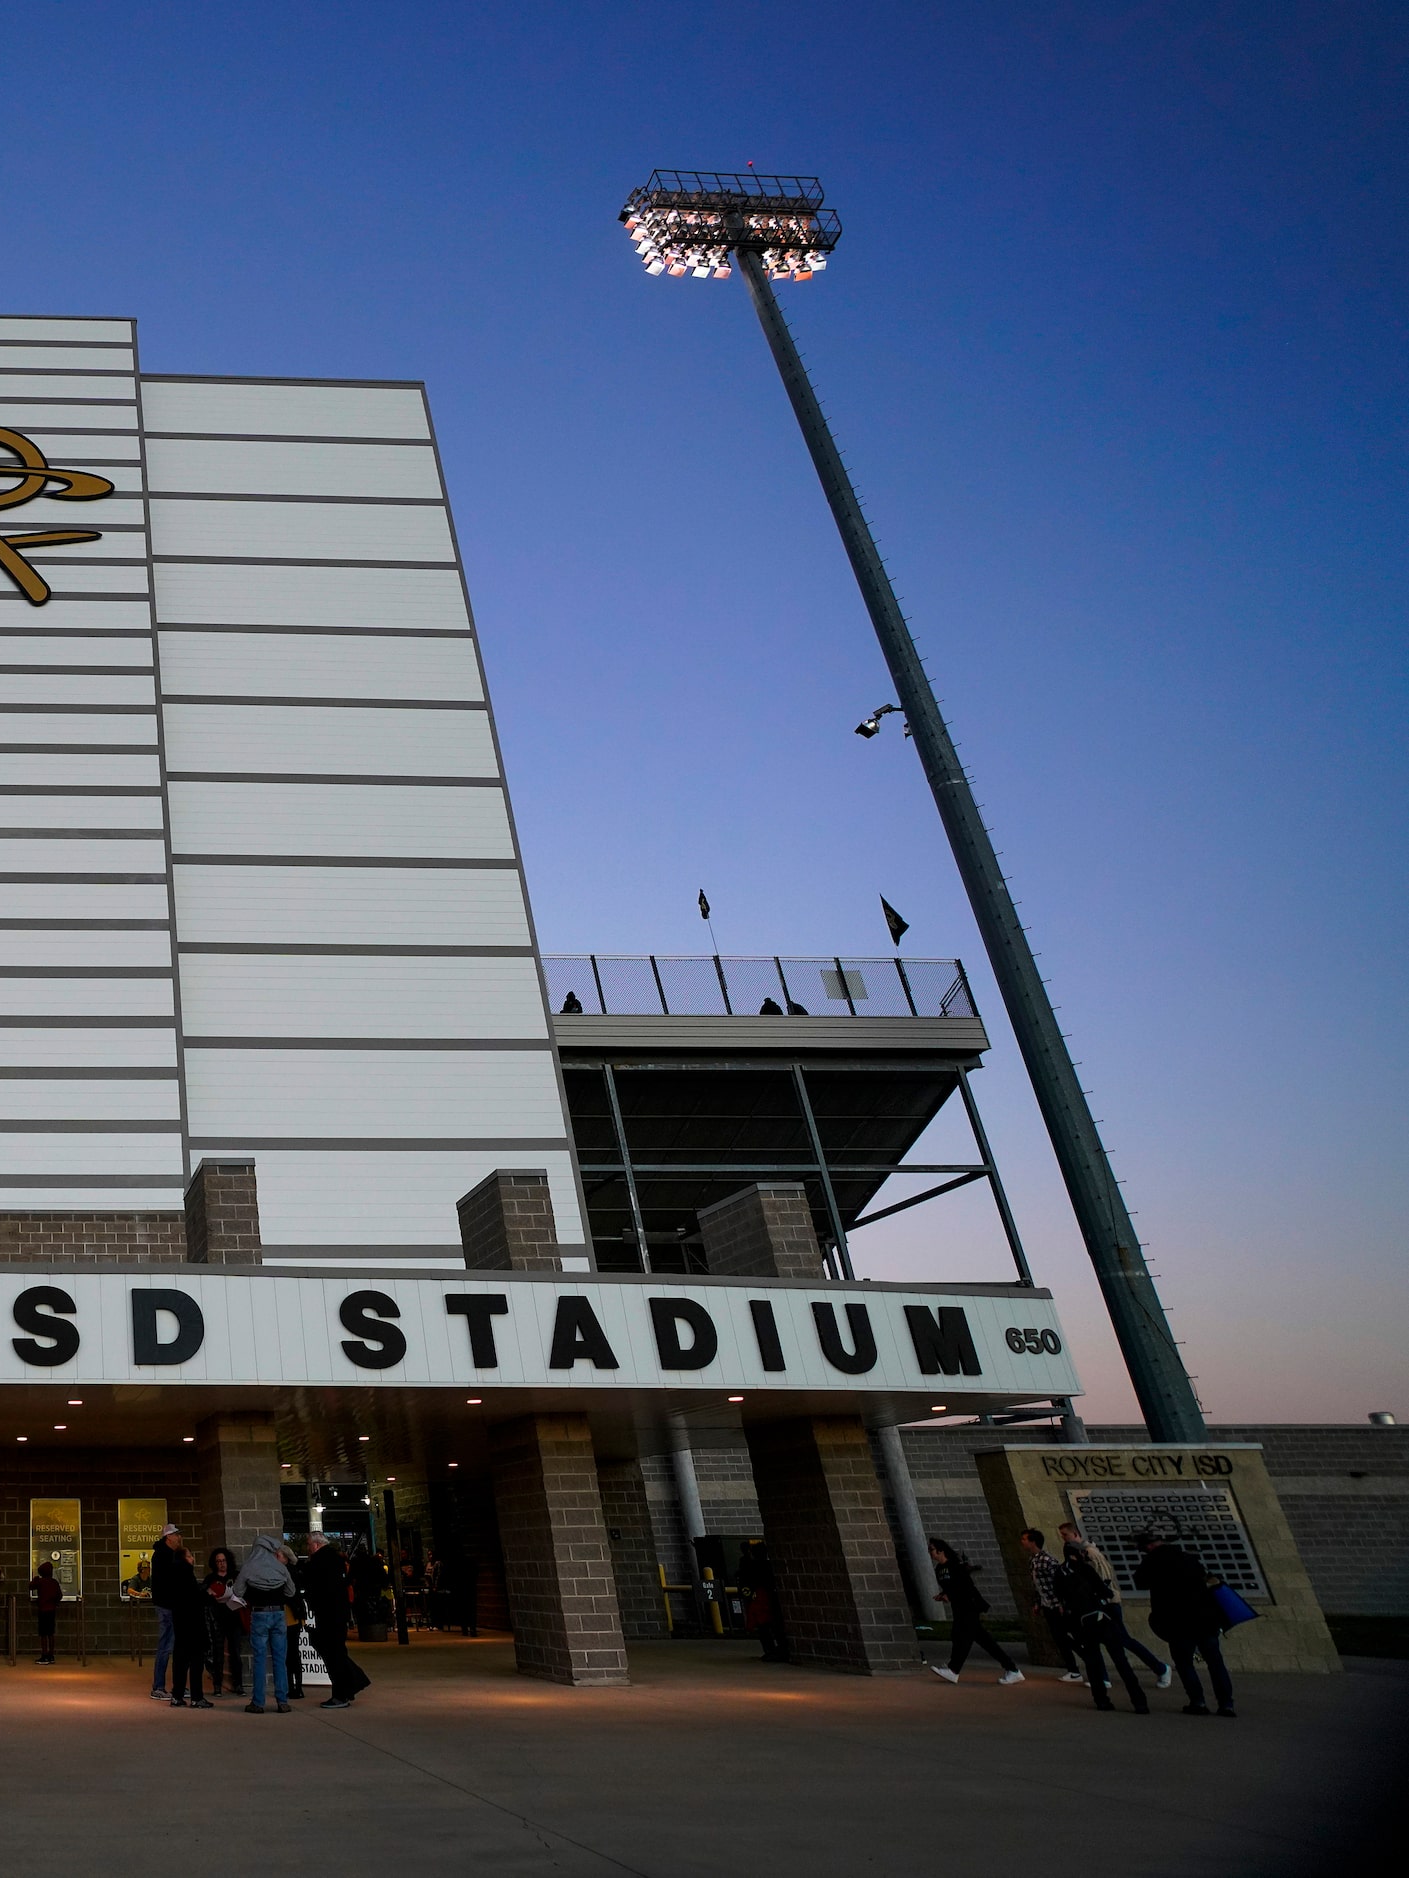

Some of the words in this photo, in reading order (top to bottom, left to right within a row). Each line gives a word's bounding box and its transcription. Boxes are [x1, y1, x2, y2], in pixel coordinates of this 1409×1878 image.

[339, 1289, 983, 1377] STADIUM
[1005, 1327, 1062, 1355] 650
[1042, 1455, 1127, 1477] ROYSE
[1132, 1455, 1184, 1476] CITY
[1192, 1455, 1234, 1476] ISD
[35, 1524, 76, 1533] RESERVED
[123, 1524, 163, 1533] RESERVED
[39, 1534, 73, 1543] SEATING
[127, 1534, 160, 1543] SEATING
[707, 1589, 713, 1599] 2
